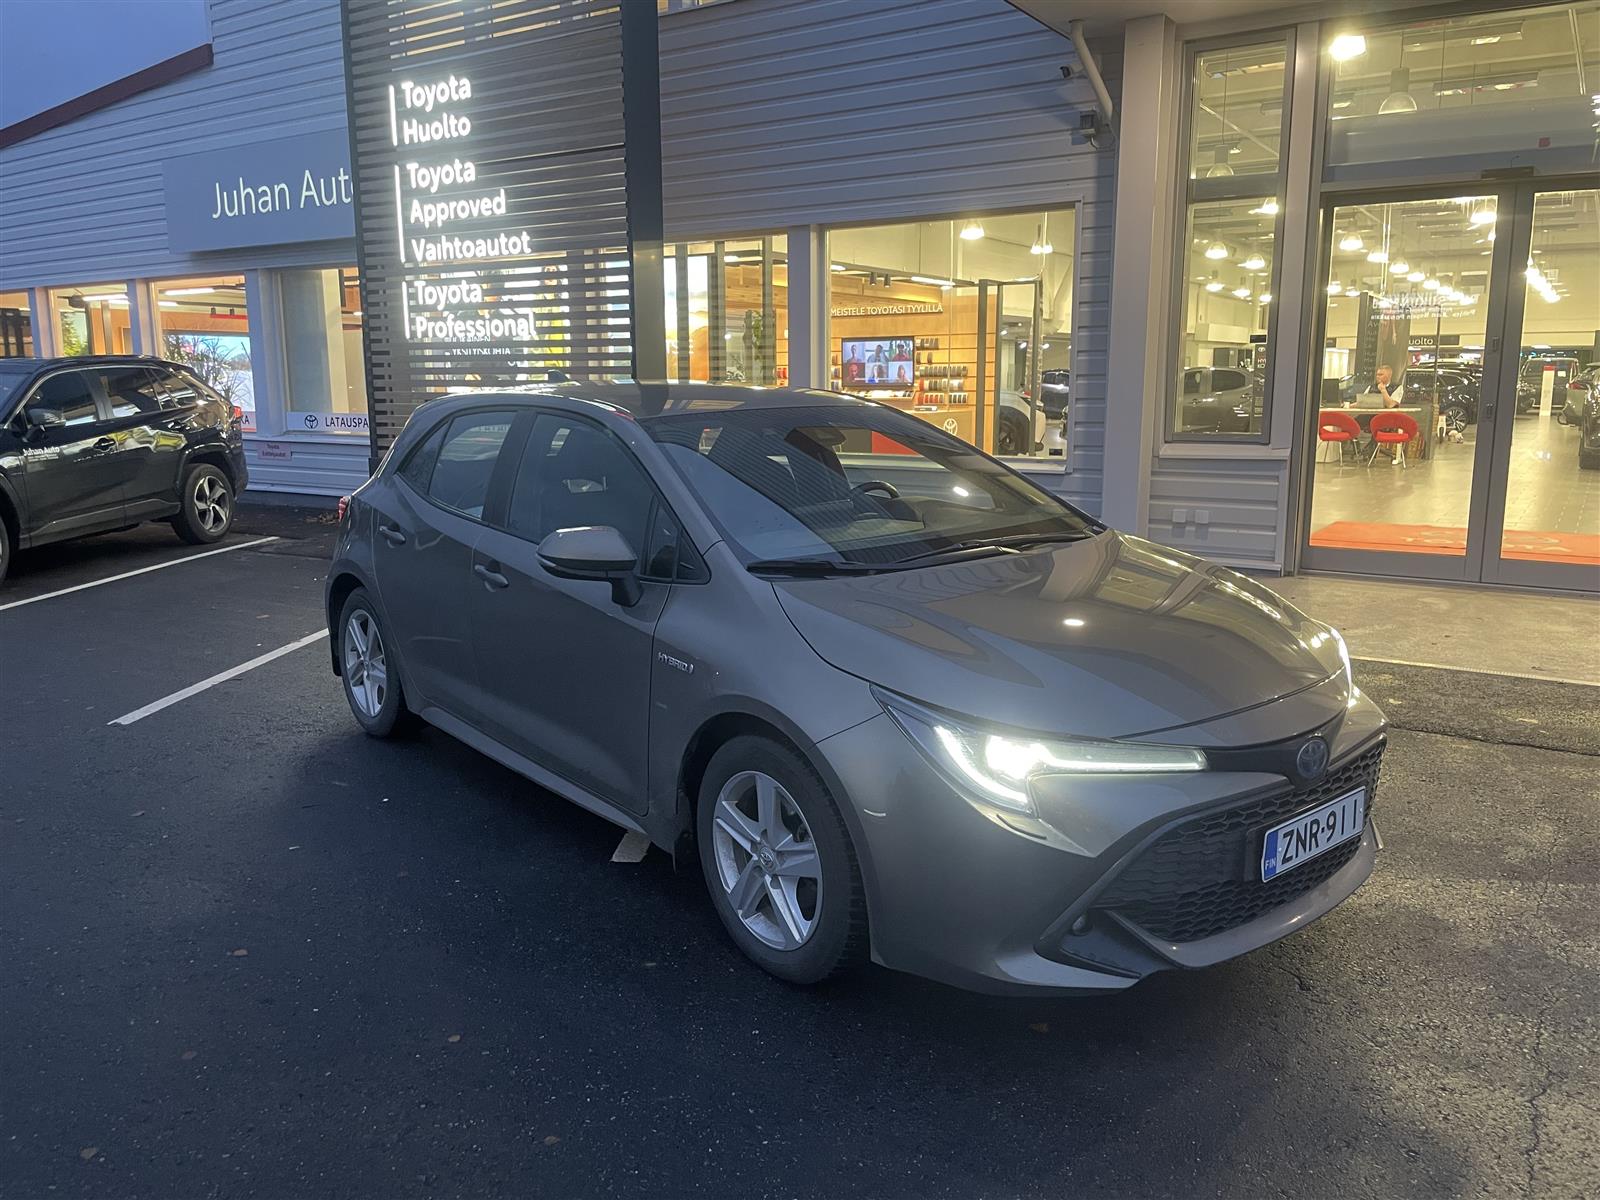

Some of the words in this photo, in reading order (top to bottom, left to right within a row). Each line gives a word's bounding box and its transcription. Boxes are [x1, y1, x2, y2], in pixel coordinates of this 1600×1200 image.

[401, 74, 472, 112] Toyota
[403, 112, 471, 145] Huolto
[406, 158, 476, 193] Toyota
[212, 177, 290, 219] Juhan
[300, 167, 354, 208] Aut
[410, 188, 506, 228] Approved
[411, 231, 532, 262] Vaihtoautot
[414, 279, 482, 310] Toyota
[867, 305, 905, 315] TOYOTASI
[907, 303, 943, 313] TYYLILLÄ
[414, 311, 536, 340] Professional
[1264, 857, 1276, 871] FIN
